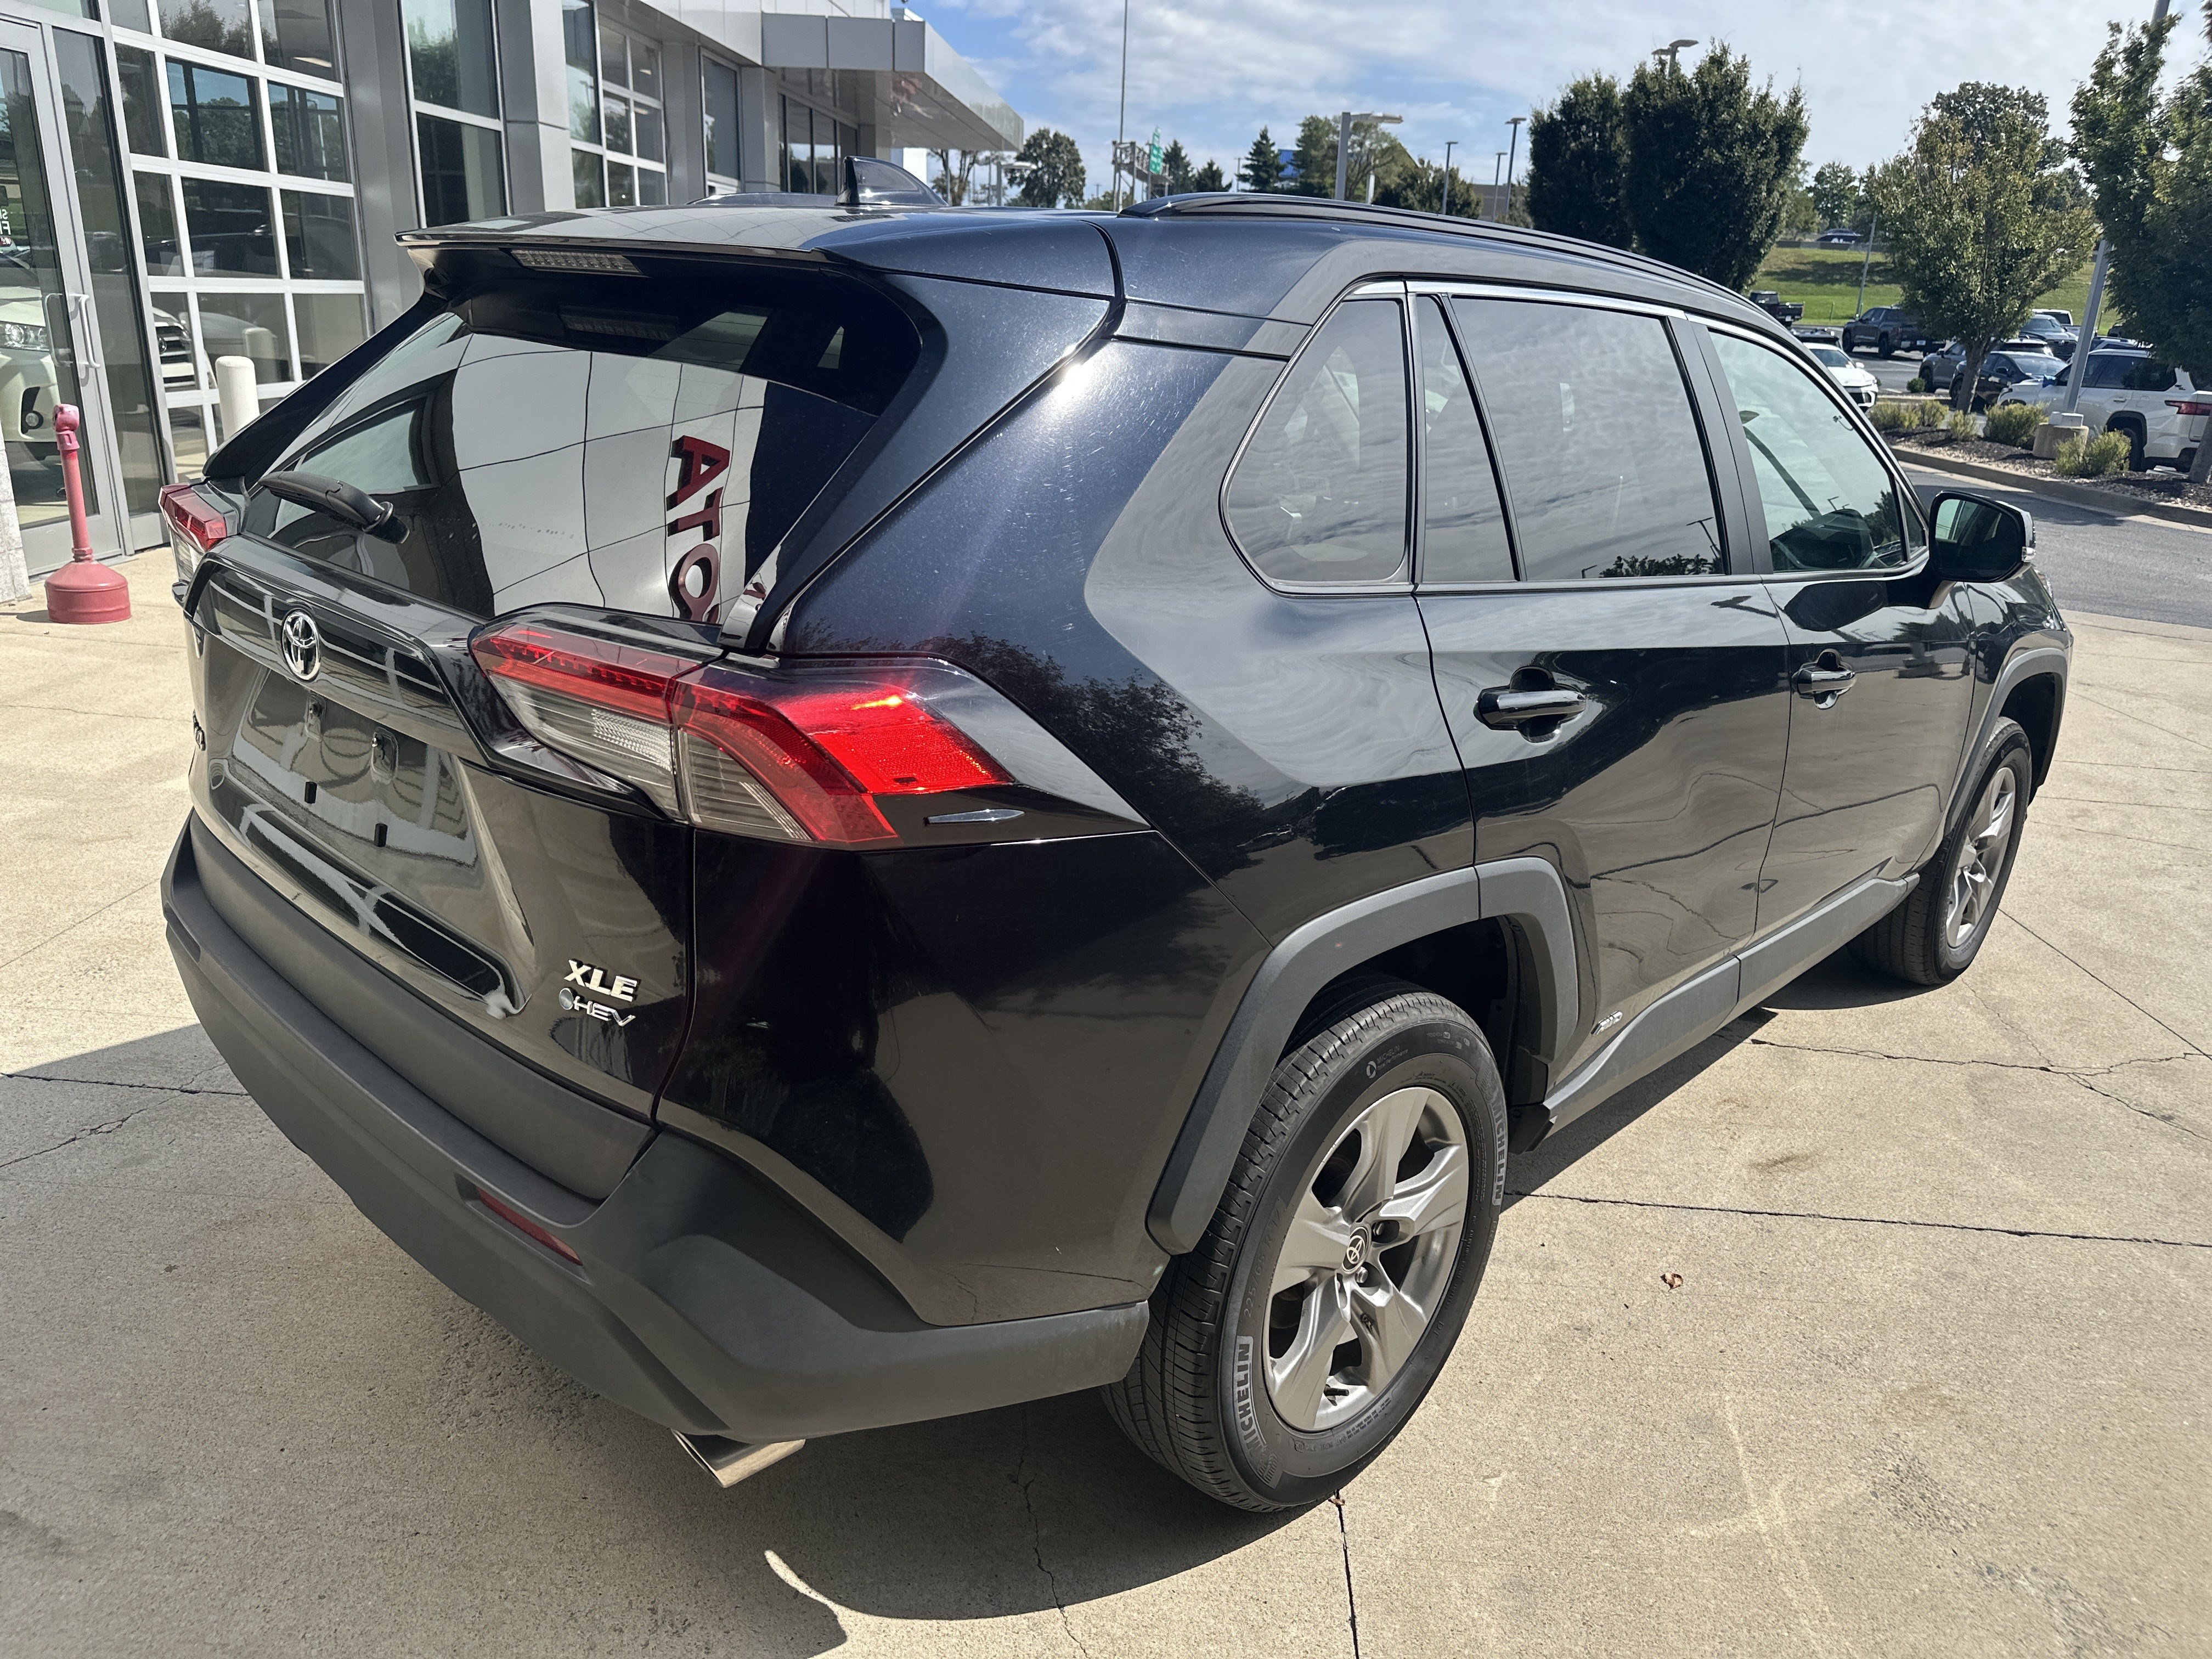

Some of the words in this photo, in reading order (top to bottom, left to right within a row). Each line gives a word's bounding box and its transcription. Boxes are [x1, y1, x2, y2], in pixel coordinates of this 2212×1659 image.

[564, 960, 637, 1002] XLE
[573, 996, 636, 1026] HEV
[1491, 1098, 1505, 1200] MICHELIN
[1237, 1344, 1262, 1458] MICHELIN
